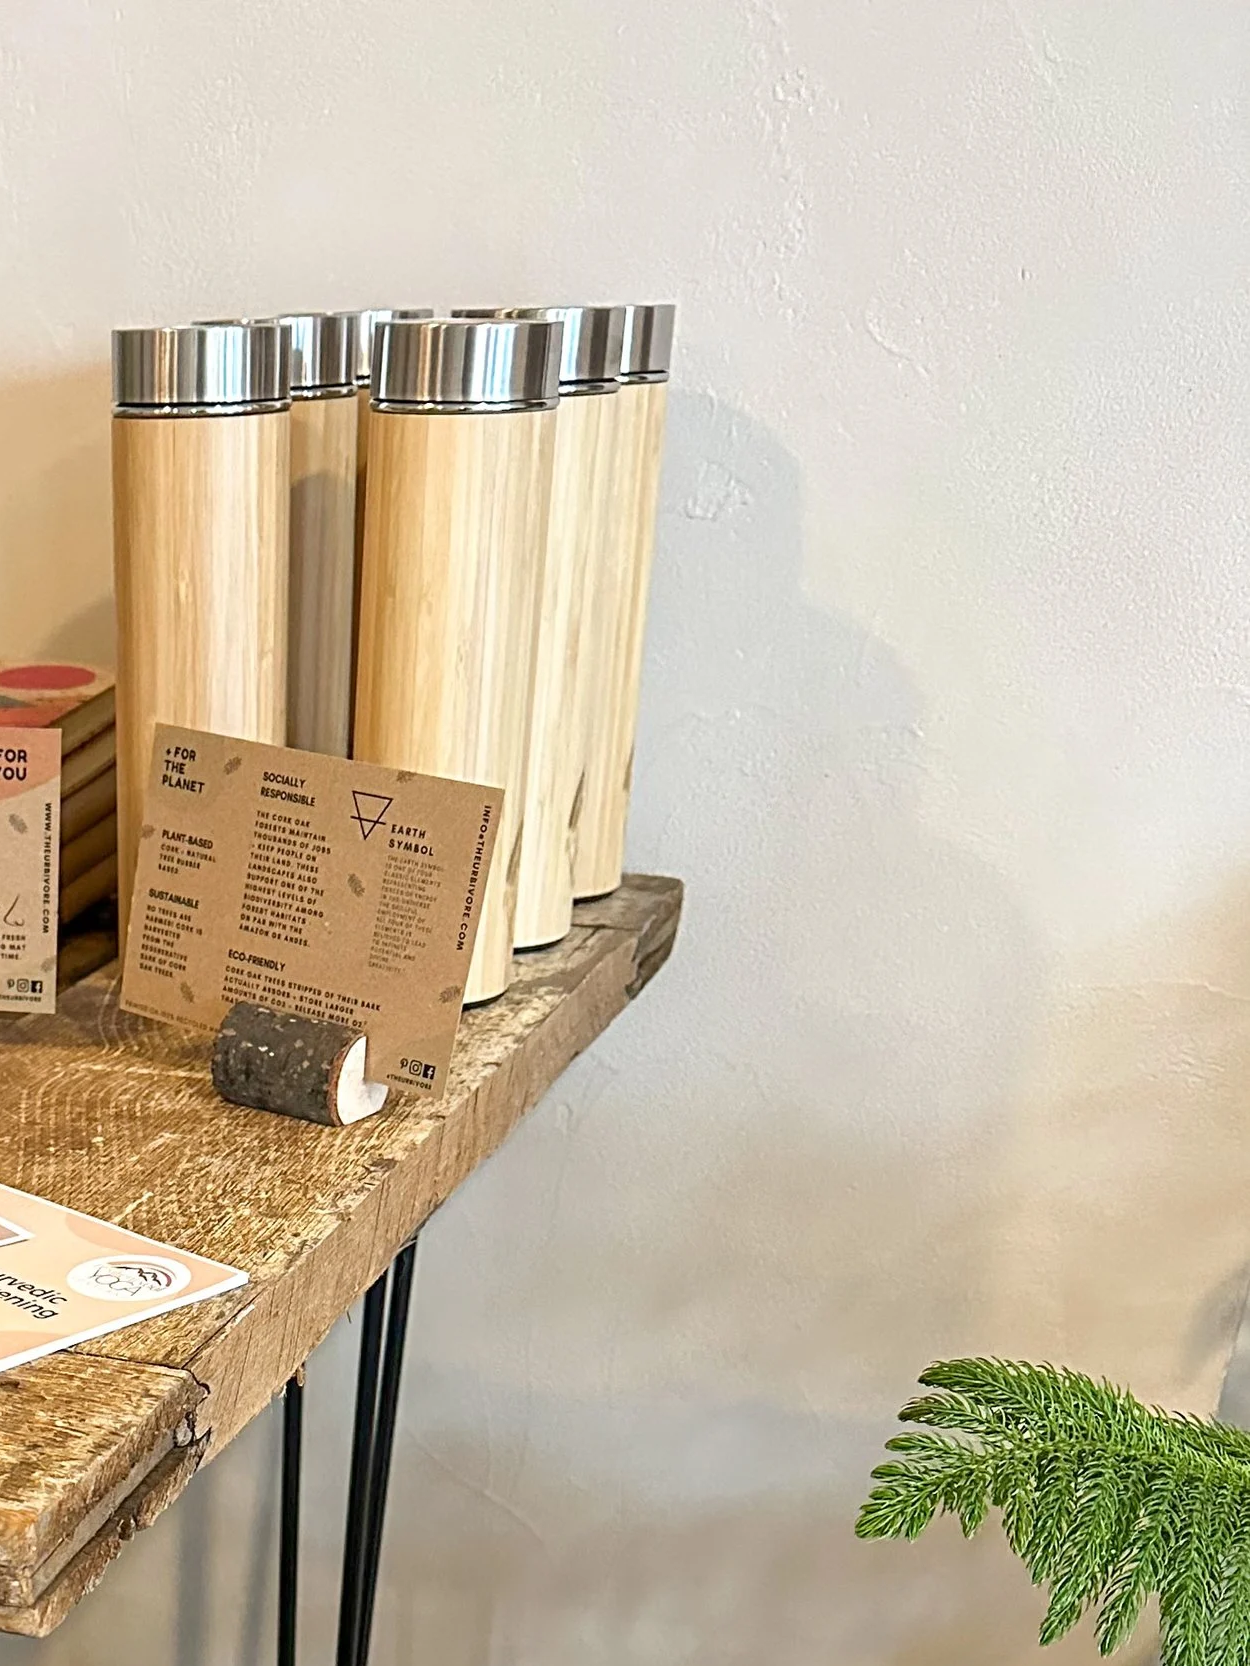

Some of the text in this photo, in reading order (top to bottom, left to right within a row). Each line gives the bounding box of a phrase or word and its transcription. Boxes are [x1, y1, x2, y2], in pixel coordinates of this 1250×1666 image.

[173, 746, 197, 762] FOR
[164, 759, 187, 775] THE
[161, 773, 206, 794] PLANET
[262, 771, 306, 789] SOCIALLY
[260, 786, 316, 807] RESPONSIBLE
[161, 829, 214, 850] PLANT-BASED
[390, 823, 427, 840] EARTH
[388, 838, 434, 857] SYMBOL
[42, 802, 52, 934] WWW.THEURBIVORE.COM
[456, 805, 492, 951] INFO@THEURBIVORE.COM
[148, 888, 200, 910] SUSTAINABLE
[228, 948, 286, 972] ECO-FRIENDLY
